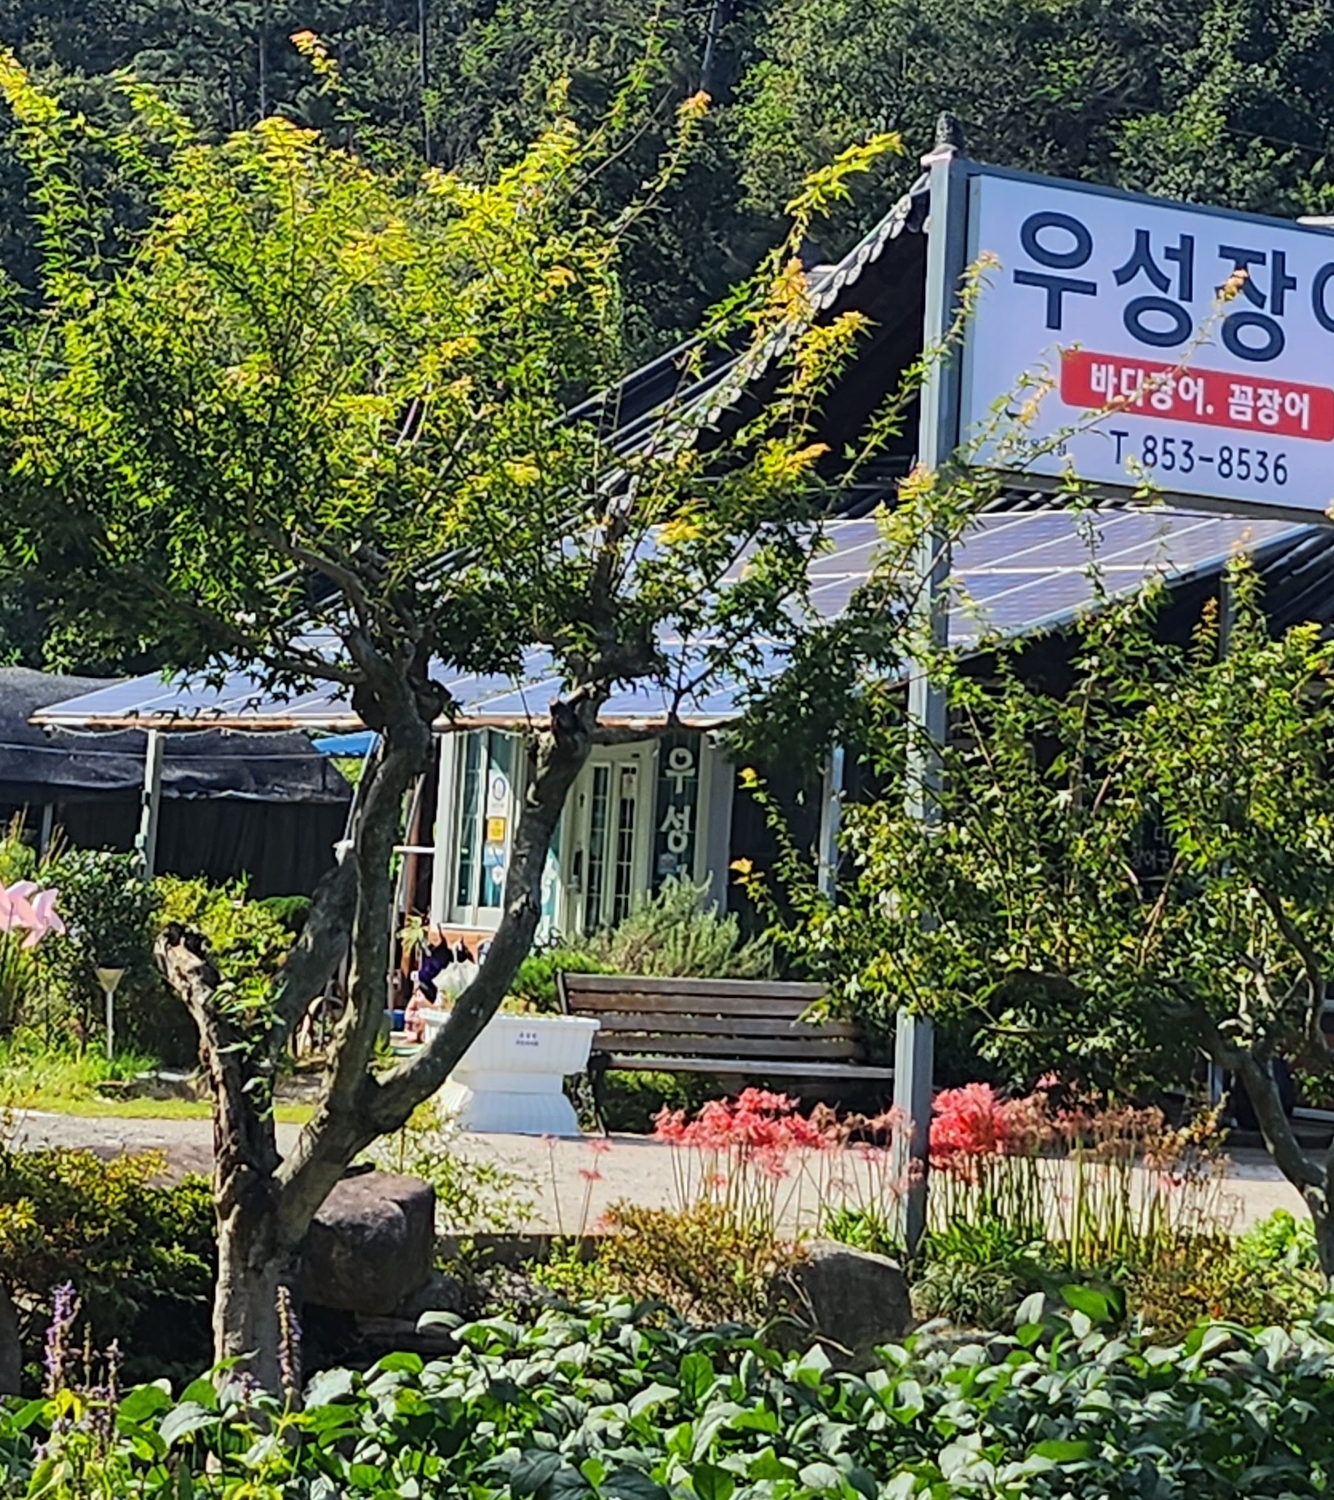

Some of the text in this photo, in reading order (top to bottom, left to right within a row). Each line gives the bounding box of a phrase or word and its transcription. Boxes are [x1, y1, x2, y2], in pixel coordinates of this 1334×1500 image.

[1228, 383, 1310, 431] 꼼장어
[1109, 430, 1129, 465] T
[1142, 435, 1288, 486] 853-8536
